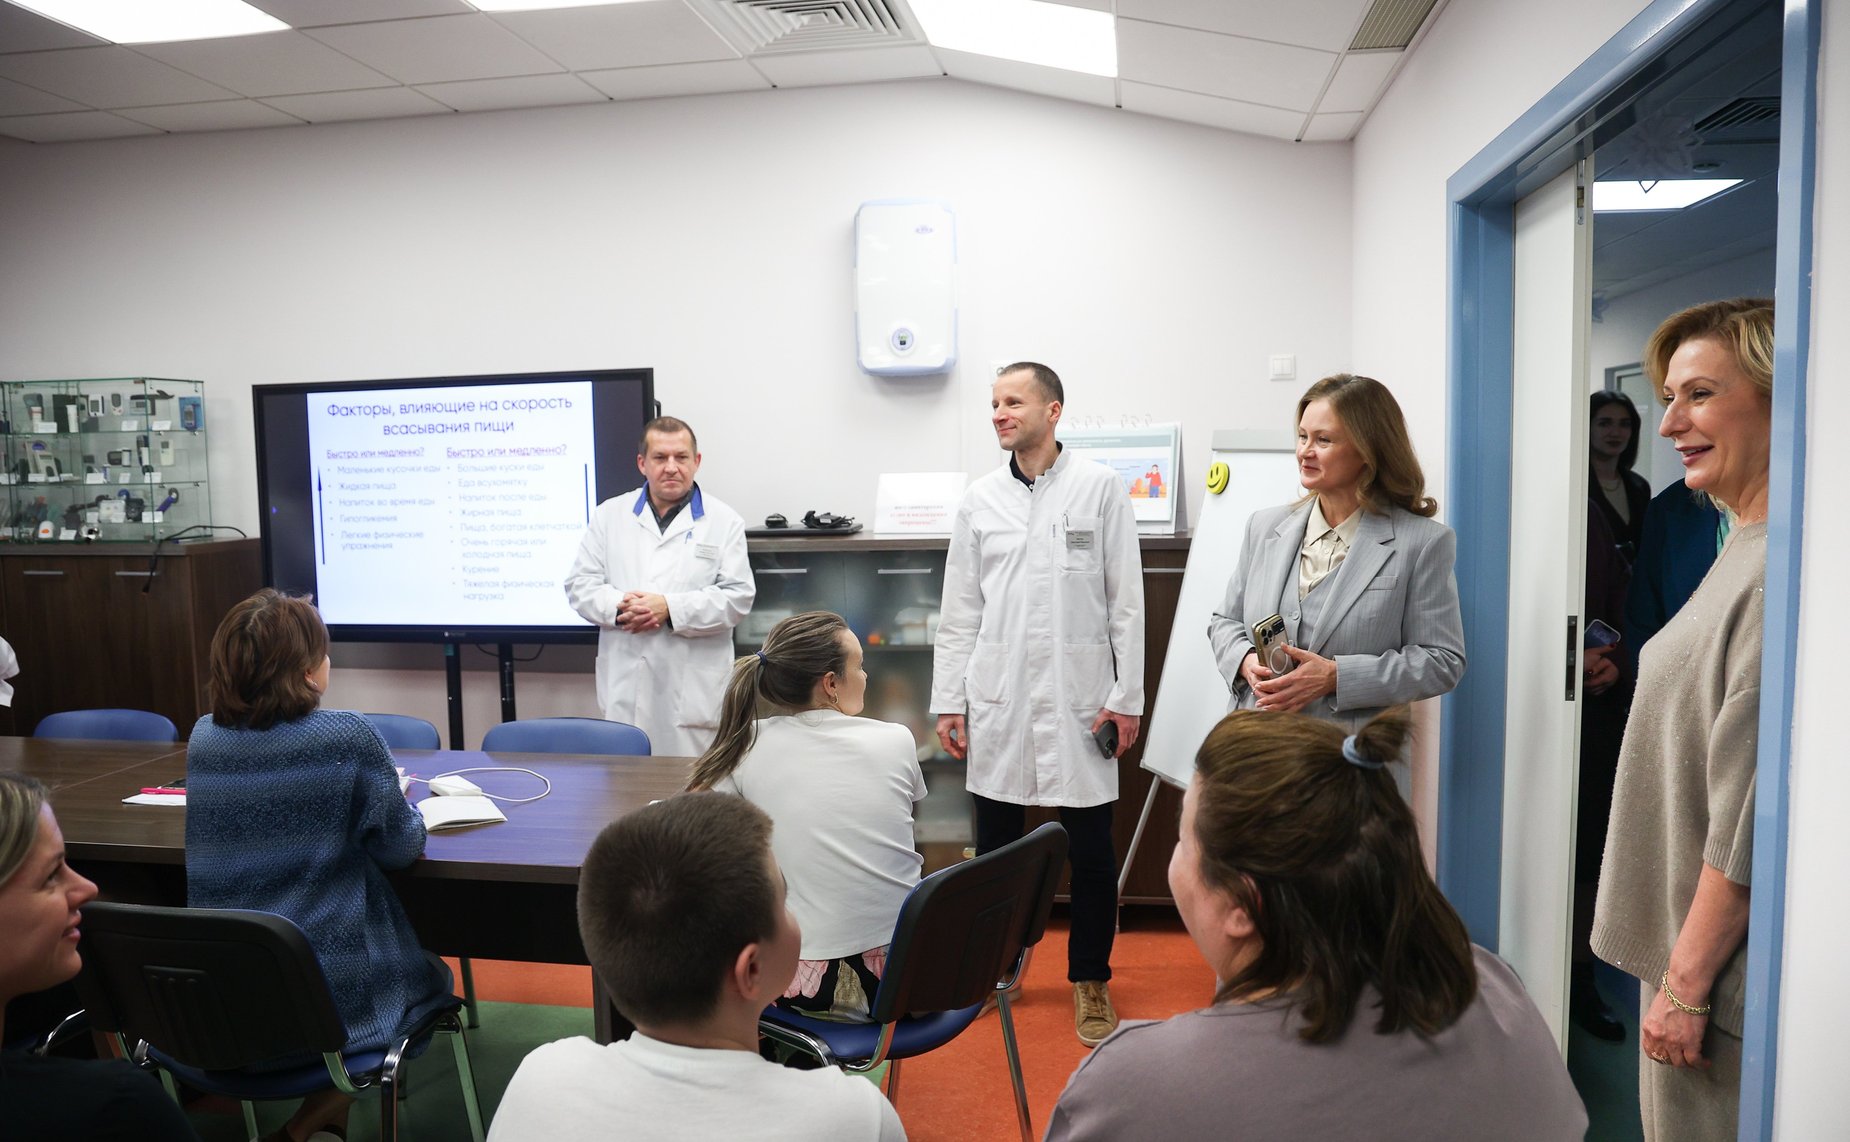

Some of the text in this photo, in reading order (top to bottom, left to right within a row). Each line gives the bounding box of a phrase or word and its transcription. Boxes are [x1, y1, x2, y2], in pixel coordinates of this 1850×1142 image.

[327, 397, 573, 419] Факторы, влияющие на скорость
[383, 420, 514, 436] всасывания пищи
[326, 447, 425, 459] Быстро или медленно?
[447, 444, 567, 458] Быстро или медленно?
[337, 465, 441, 475] Маленькие кусочки еды
[457, 463, 544, 473] Большие куски еды
[339, 482, 396, 491] Жидкая пища
[458, 479, 528, 488] Еда всухомятку
[339, 498, 374, 507] Напиток
[459, 494, 547, 502] Напиток после еды
[497, 509, 521, 517] пища
